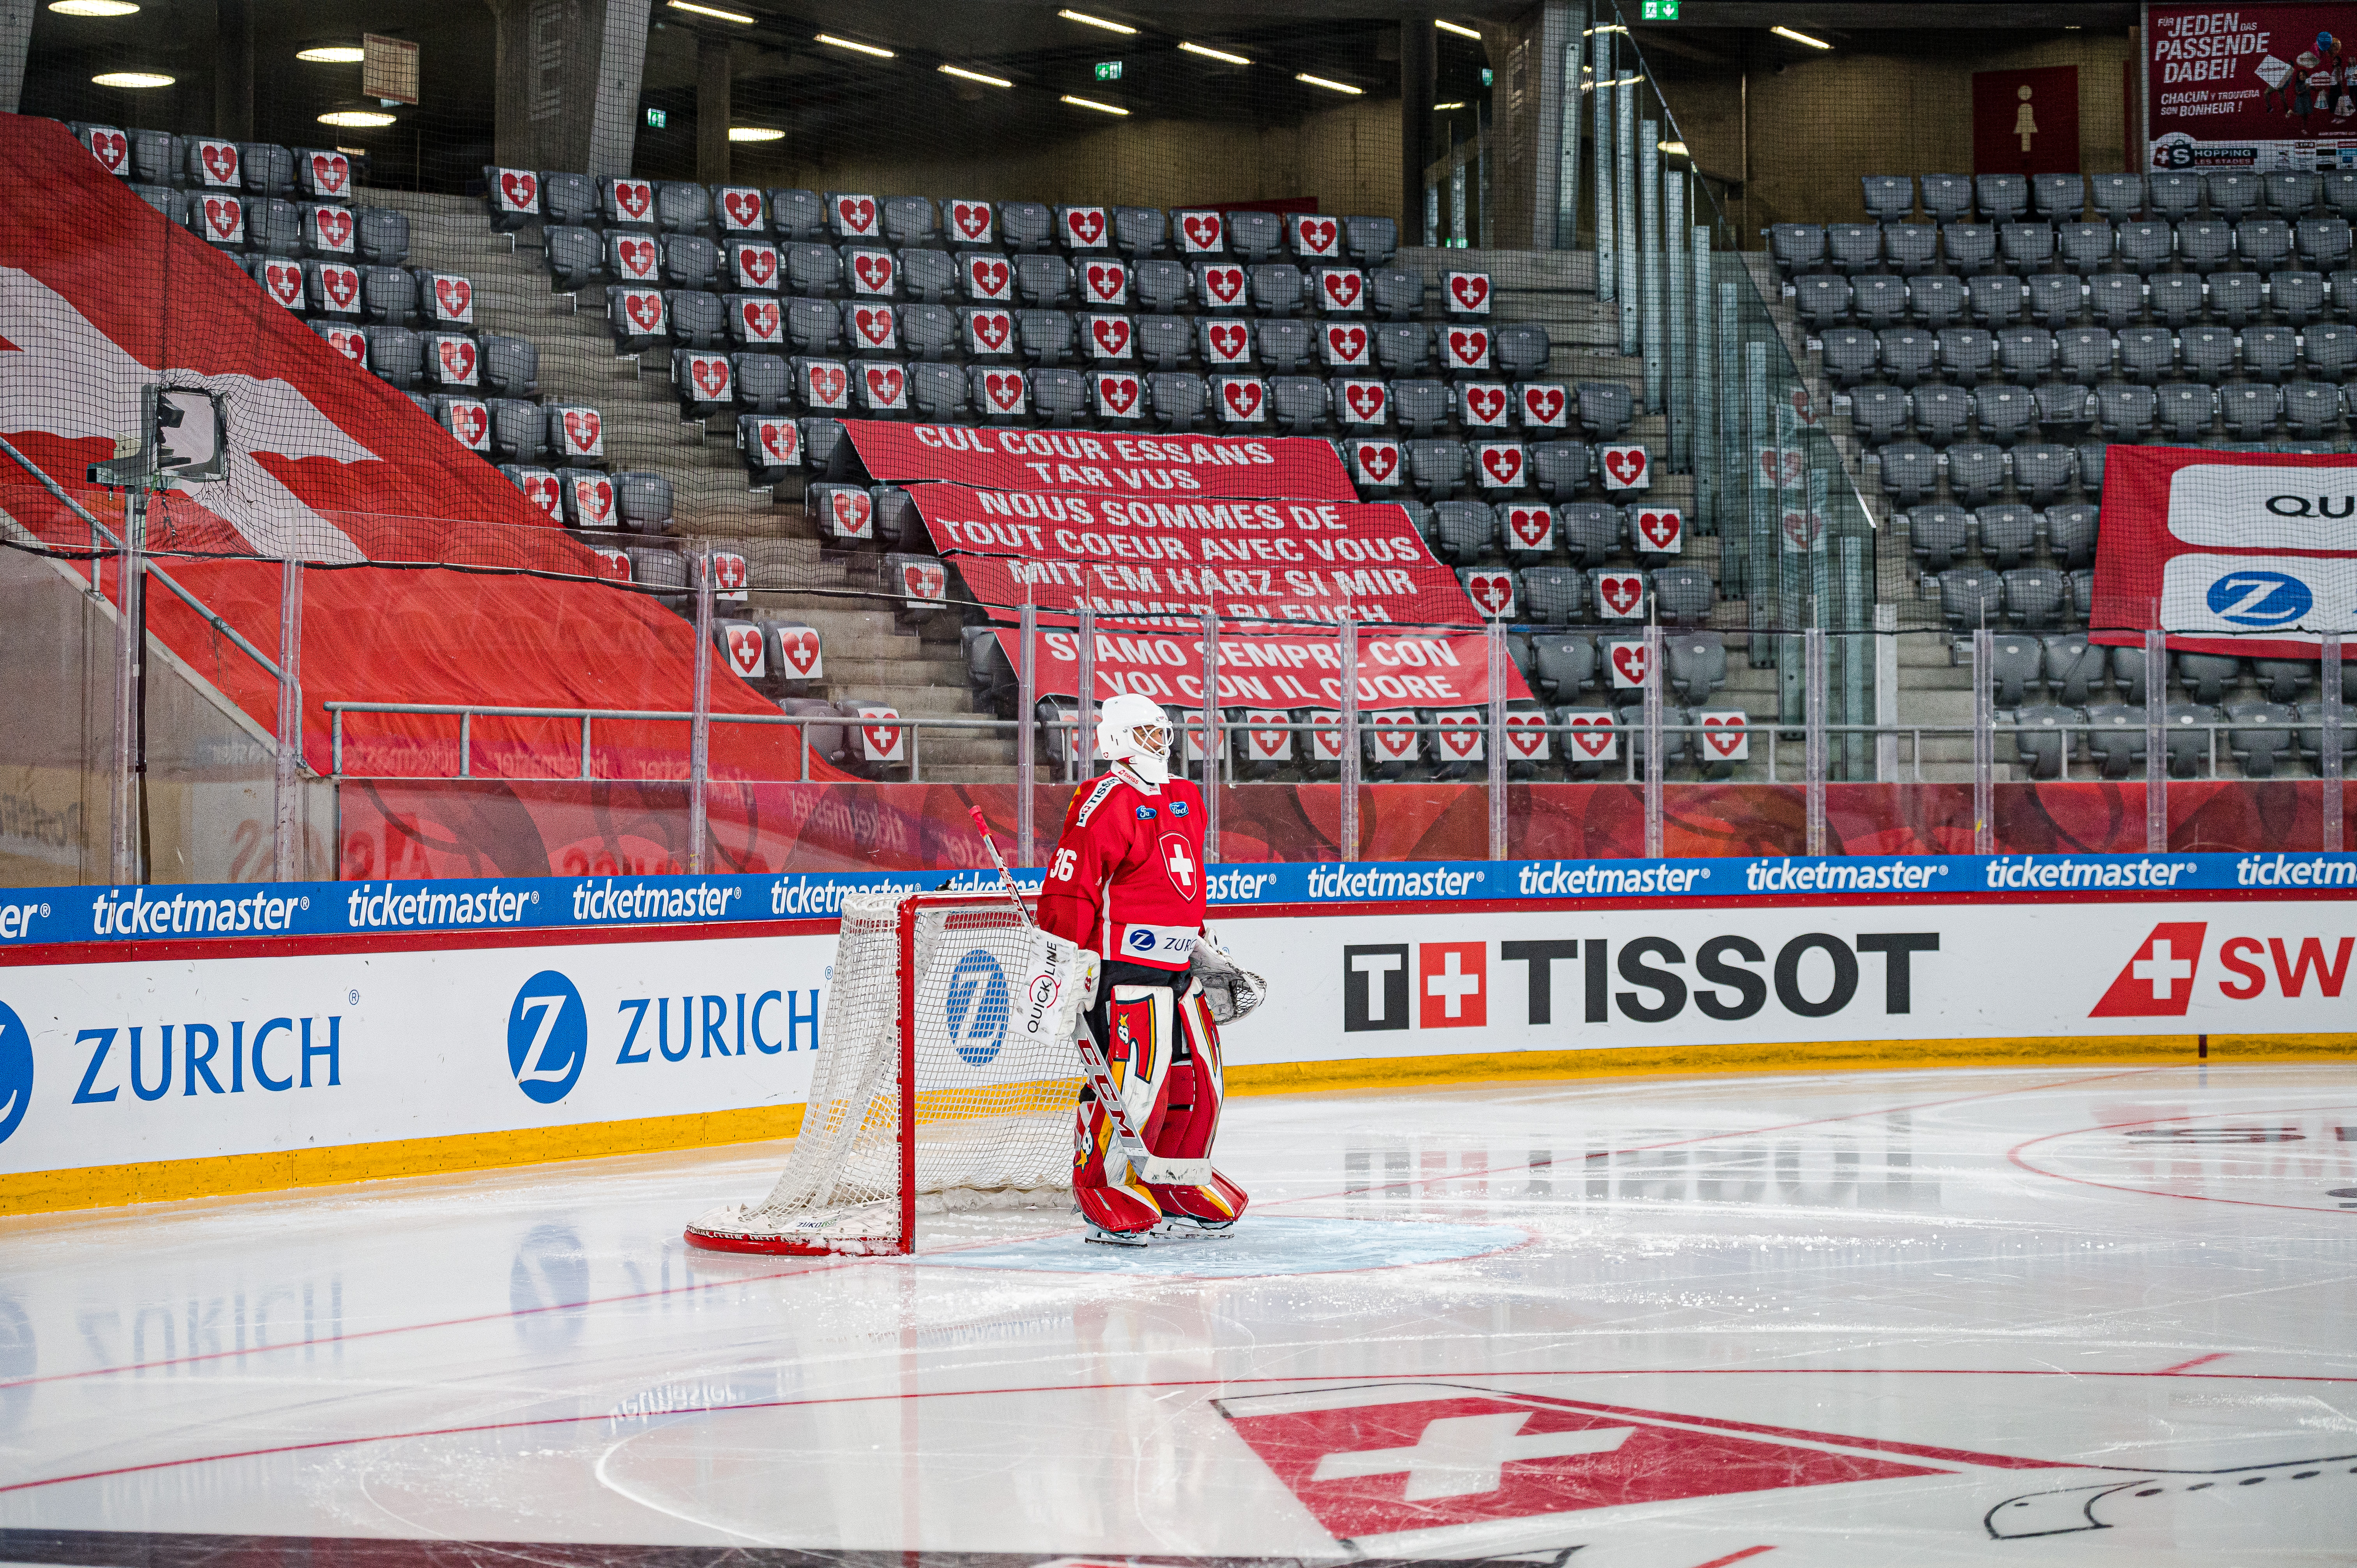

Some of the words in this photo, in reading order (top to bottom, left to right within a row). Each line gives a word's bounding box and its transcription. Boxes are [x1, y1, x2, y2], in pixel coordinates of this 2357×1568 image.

[2168, 12, 2239, 37] JEDEN
[2240, 22, 2257, 31] DAS
[2154, 32, 2270, 61] PASSENDE
[2163, 58, 2237, 83] DABEI!
[2161, 90, 2209, 105] CHACUN
[2179, 102, 2235, 117] BONHEUR
[914, 426, 995, 453] CUL
[999, 431, 1110, 460] COUR
[1113, 440, 1274, 466] ESSANS
[1026, 463, 1113, 487] TAR
[1112, 467, 1200, 489] VUS
[977, 491, 1093, 523] NOUS
[1095, 500, 1285, 530] SOMMES
[1288, 505, 1347, 531] DE
[935, 518, 1044, 551] TOUT
[1055, 526, 1194, 561] COEUR
[1203, 535, 1303, 561] AVEC
[1304, 537, 1421, 562] VOUS
[1007, 559, 1084, 586] MIT
[1285, 570, 1330, 596] SI
[1331, 570, 1418, 595] MIR
[1368, 639, 1460, 667] CON
[1096, 671, 1174, 697] VOI
[1273, 675, 1320, 699] IL
[1124, 772, 1139, 784] SWISS
[1050, 848, 1077, 881] 36
[998, 867, 1023, 912] CCM
[1501, 932, 1939, 1025] TISSOT
[615, 989, 820, 1065] ZURICH
[72, 1016, 342, 1104] ZURICH
[1077, 1034, 1137, 1139] CCM
